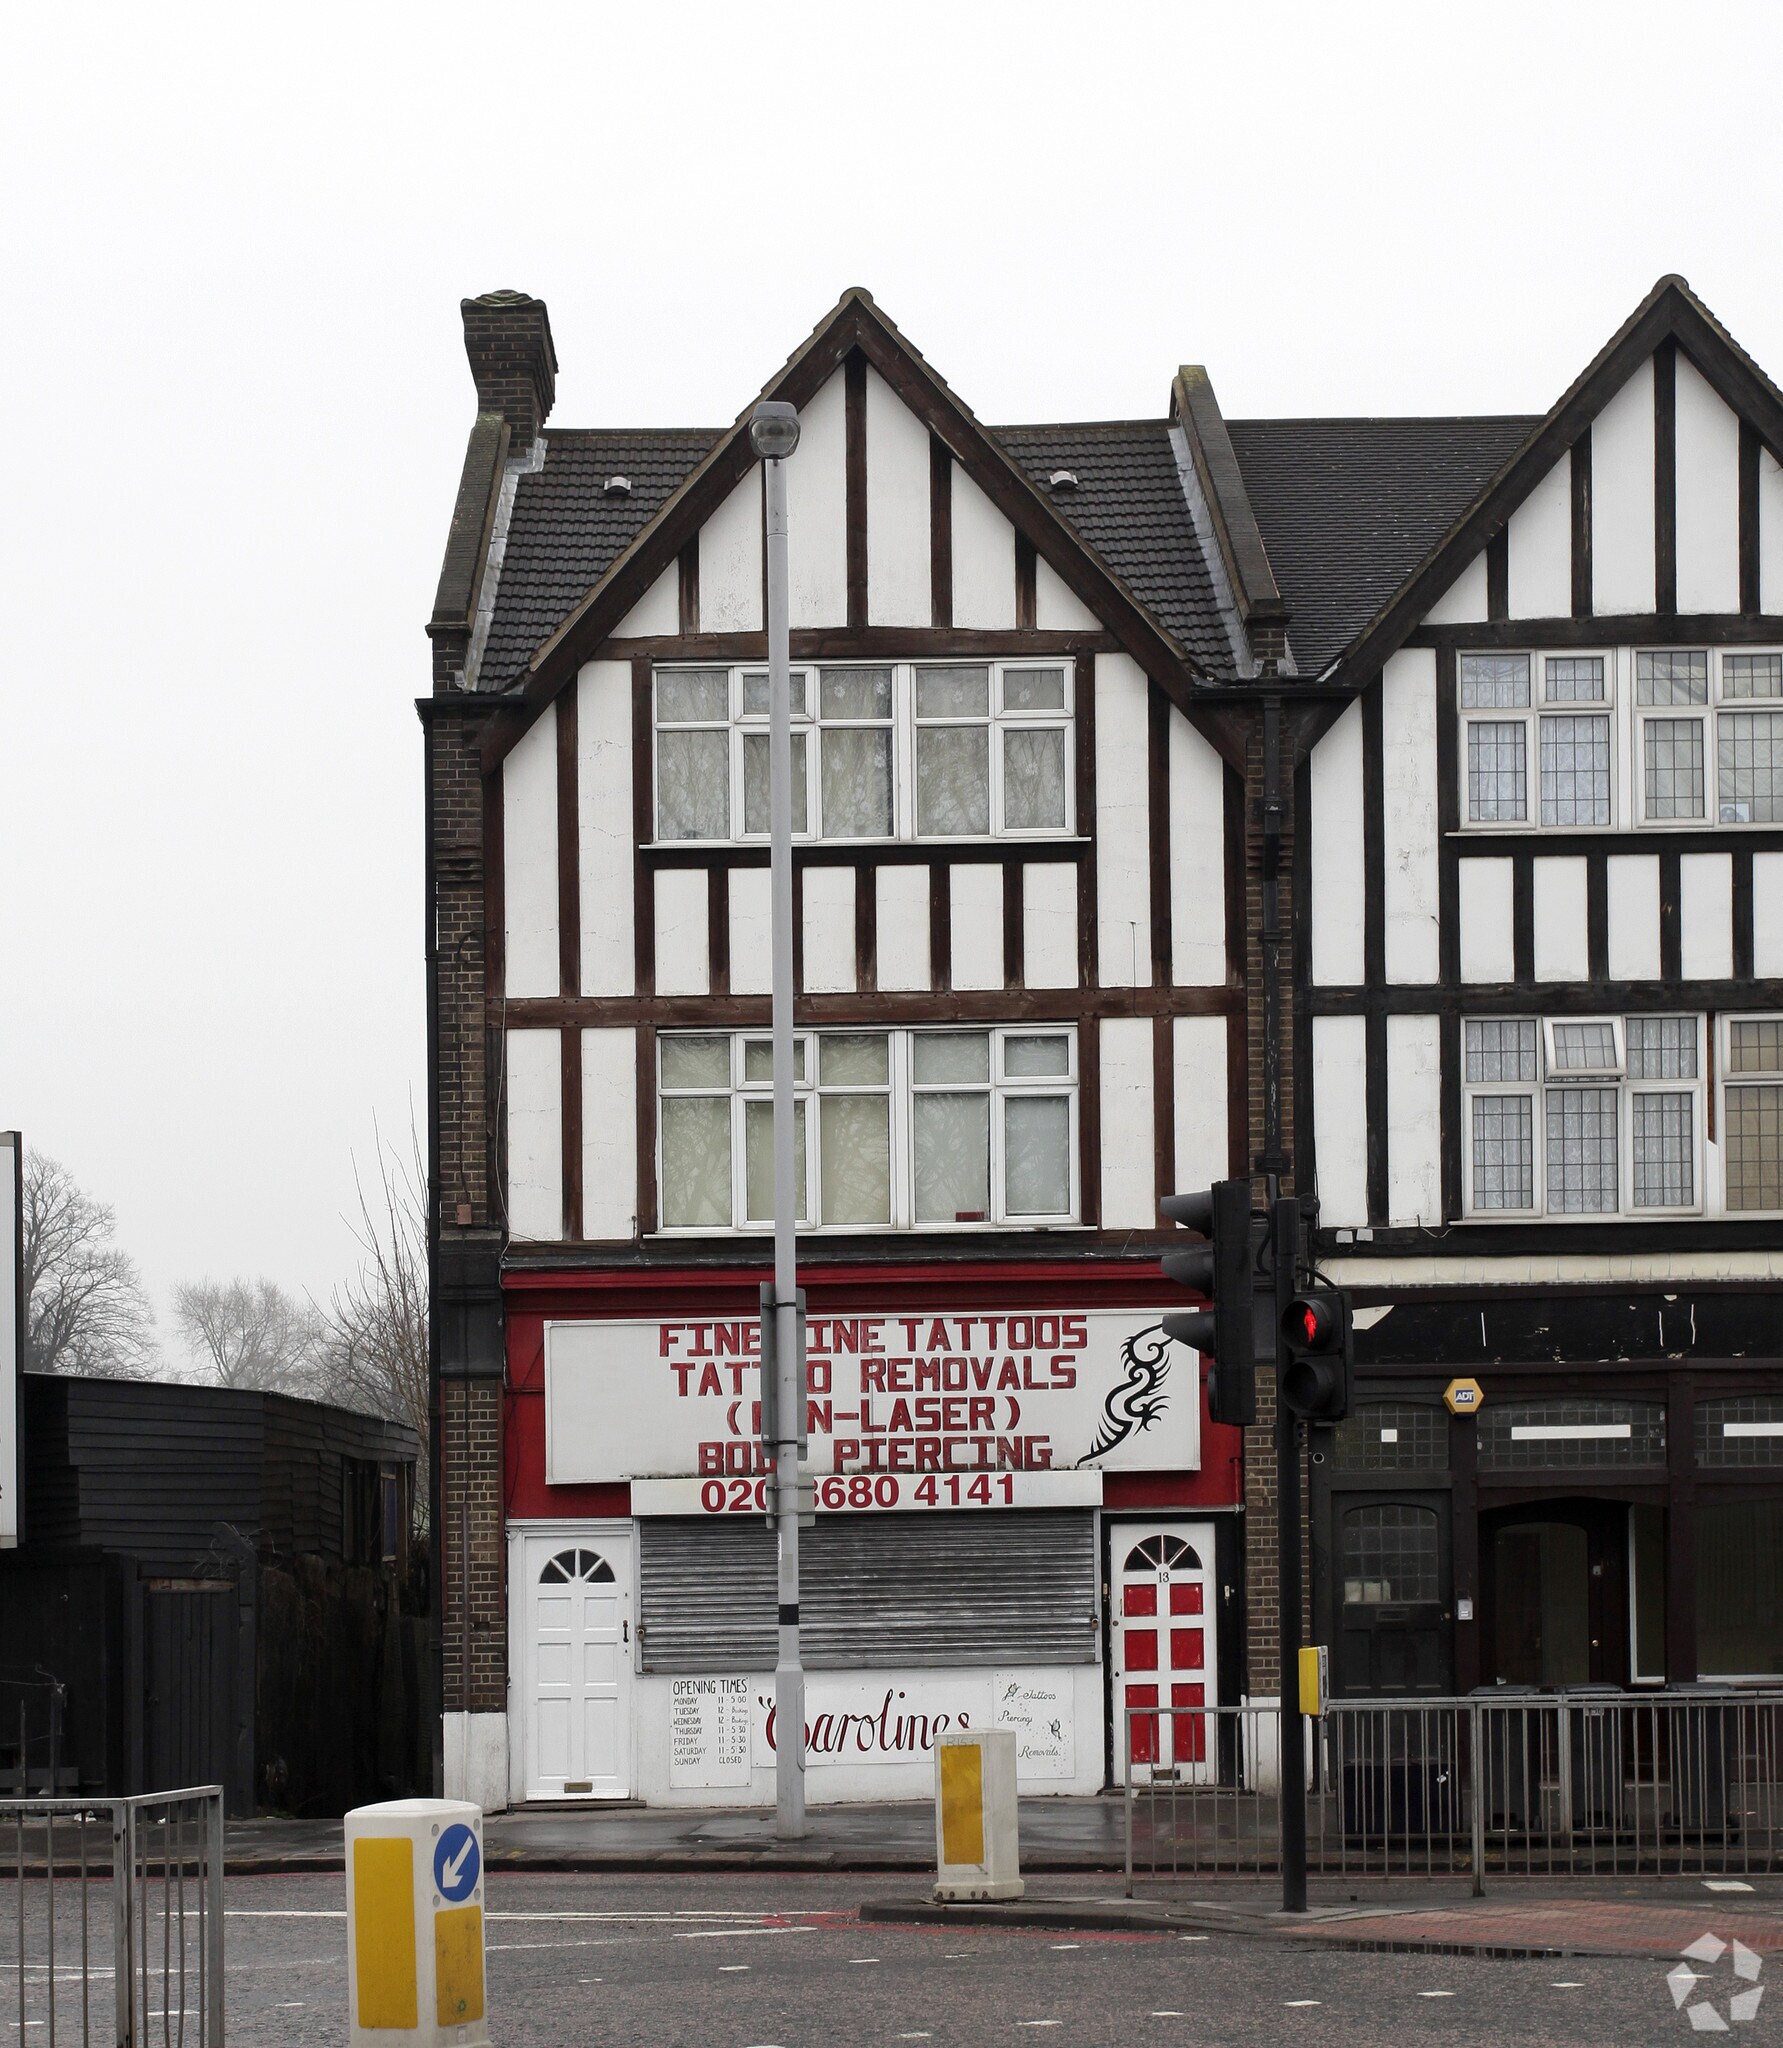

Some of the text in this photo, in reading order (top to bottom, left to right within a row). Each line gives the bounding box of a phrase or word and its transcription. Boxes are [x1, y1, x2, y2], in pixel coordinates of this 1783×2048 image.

[659, 1315, 1087, 1357] FINE INE TATTOOS
[670, 1355, 1076, 1397] TATO REMOVALS
[1455, 1391, 1475, 1401] ADT
[833, 1435, 1053, 1475] PIERCING
[813, 1476, 900, 1510] 680
[914, 1473, 1014, 1507] 4141
[1158, 1572, 1170, 1583] 13
[673, 1678, 748, 1695] OPENING TIMES
[1018, 1689, 1057, 1700] Tattoos
[673, 1697, 698, 1705] MONDAY
[674, 1707, 700, 1715] TUESDAY
[673, 1717, 702, 1725] WEDNESDAY
[675, 1727, 702, 1735] THURSDAY
[673, 1737, 698, 1746] FRIDAY
[674, 1747, 707, 1756] SATURDAY
[674, 1756, 742, 1766] SUNDAY CLOSED
